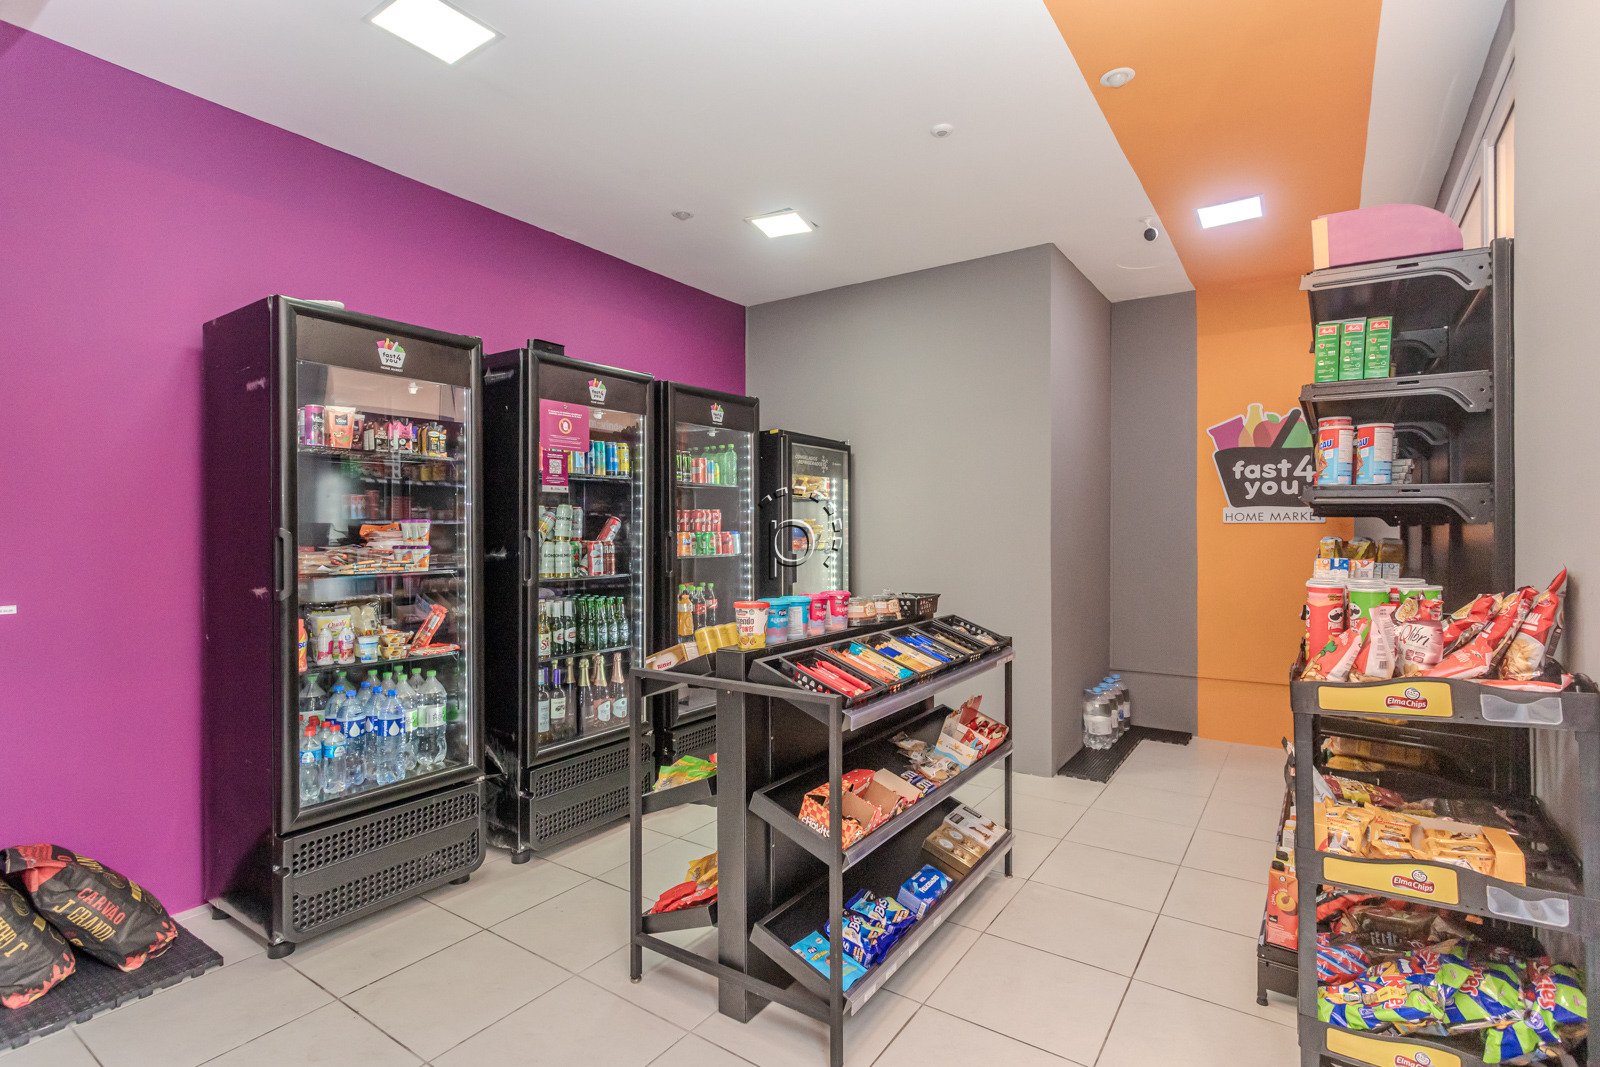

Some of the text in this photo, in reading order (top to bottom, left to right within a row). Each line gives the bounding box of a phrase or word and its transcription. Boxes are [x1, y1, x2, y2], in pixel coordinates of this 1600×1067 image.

[1244, 480, 1299, 500] you
[1225, 511, 1264, 522] HOME
[66, 906, 117, 942] GRANDI
